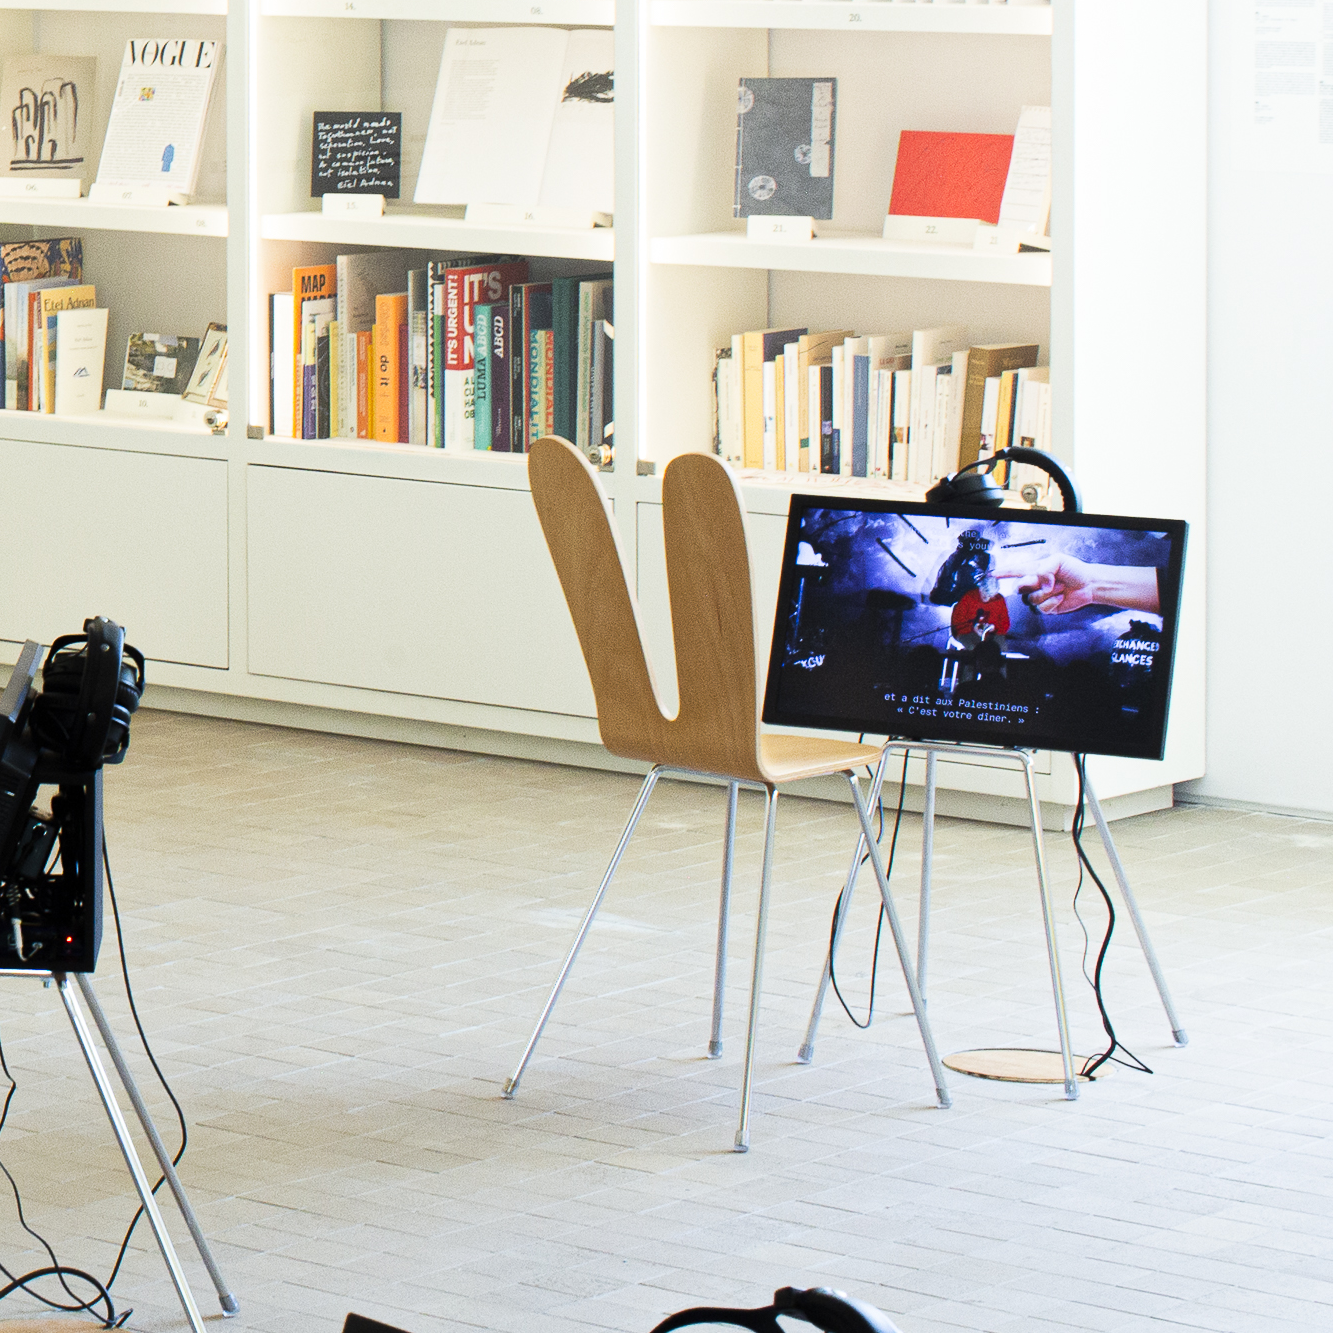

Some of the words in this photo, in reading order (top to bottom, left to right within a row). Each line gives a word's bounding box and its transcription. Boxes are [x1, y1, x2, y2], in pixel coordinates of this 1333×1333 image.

[130, 40, 216, 69] VOGUE
[302, 274, 325, 293] MAP
[463, 270, 502, 304] IT'S
[44, 299, 63, 312] Etel
[67, 297, 95, 310] Adnan
[494, 316, 505, 358] ABCD
[477, 358, 487, 401] LUMA
[530, 329, 541, 440] MONDIALIT
[884, 693, 896, 702] et
[901, 695, 908, 703] a
[913, 693, 930, 705] dit
[936, 696, 953, 706] aux
[959, 698, 1029, 714] Palestiniens
[908, 705, 938, 717] C'est
[943, 709, 972, 720] votre
